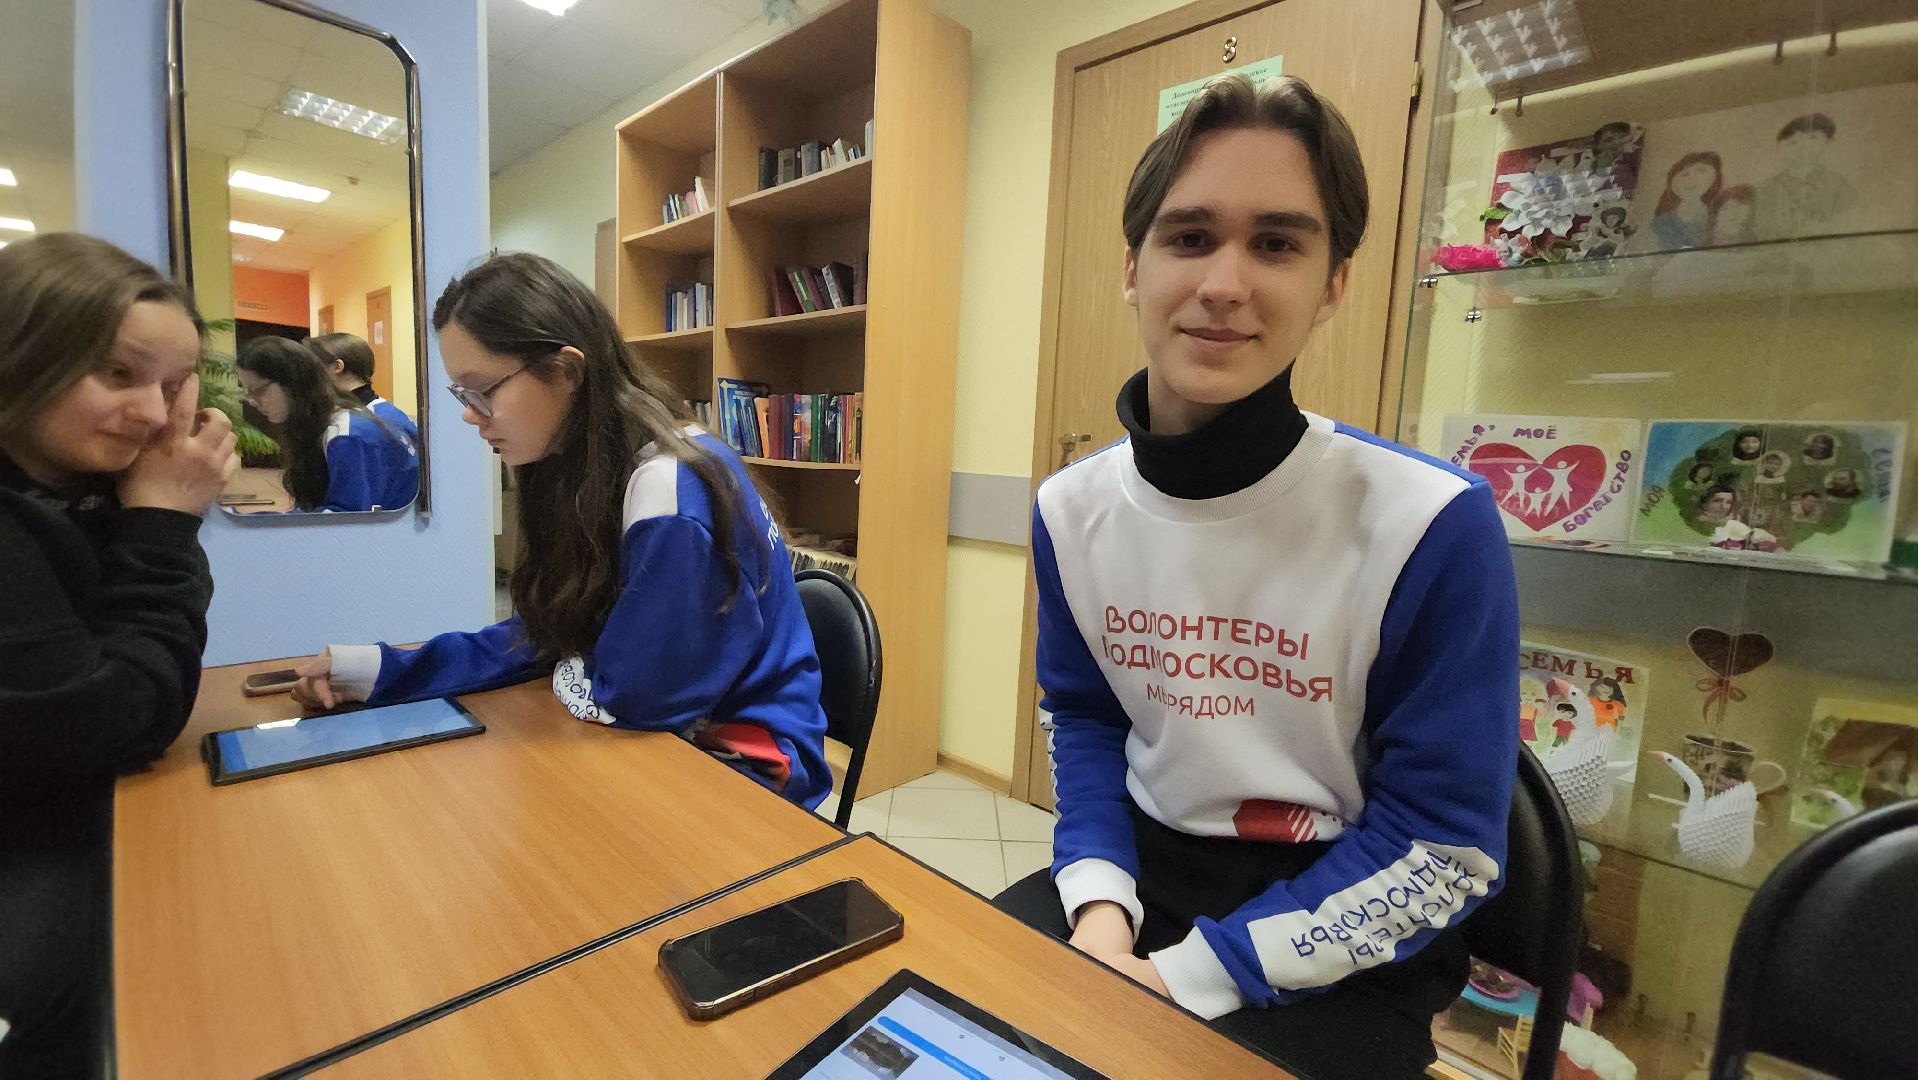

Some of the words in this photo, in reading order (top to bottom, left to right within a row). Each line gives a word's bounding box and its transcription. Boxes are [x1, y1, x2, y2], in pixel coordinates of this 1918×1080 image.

[1512, 424, 1557, 440] МОЁ
[1562, 449, 1632, 533] БОГАТСТВО
[1105, 605, 1309, 660] ВОЛОНТЕРЫ
